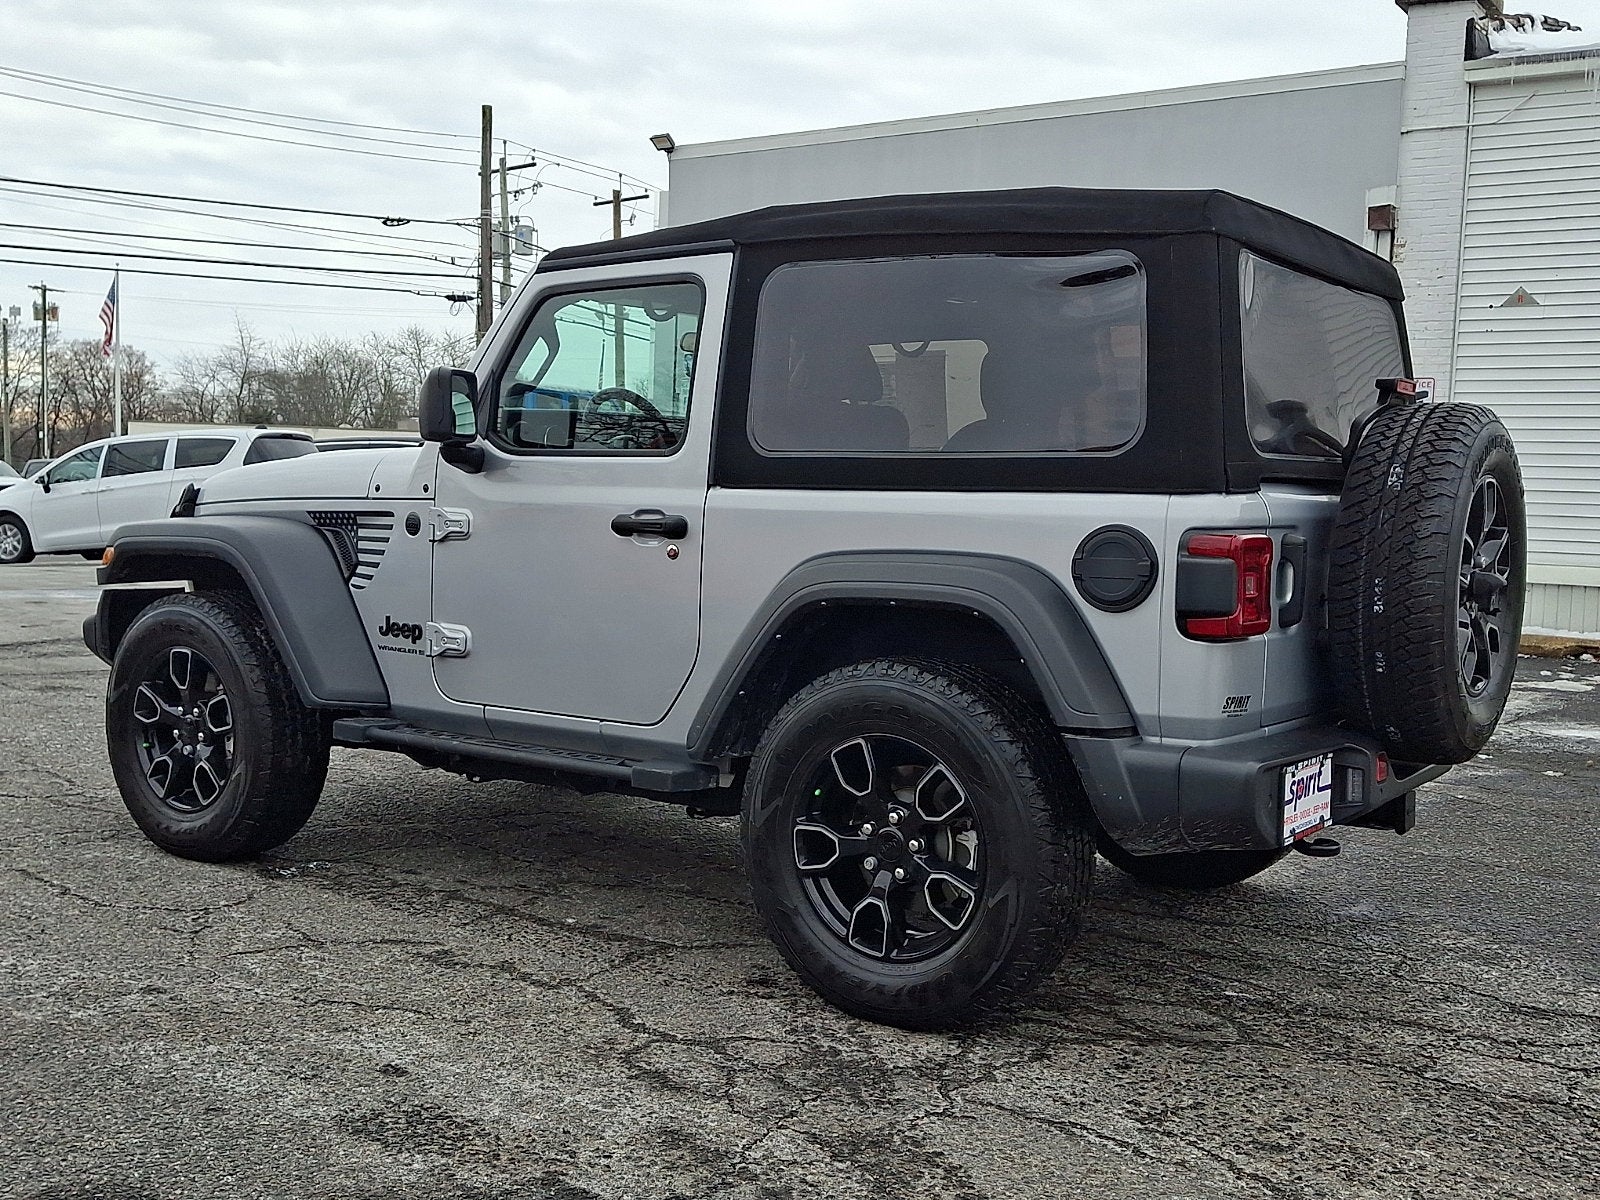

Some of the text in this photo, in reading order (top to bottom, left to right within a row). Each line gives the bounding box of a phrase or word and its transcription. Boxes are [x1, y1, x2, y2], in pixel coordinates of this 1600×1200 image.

[378, 615, 423, 645] Jeep
[377, 644, 418, 655] WRANGLER
[1222, 695, 1252, 710] SPIRIT
